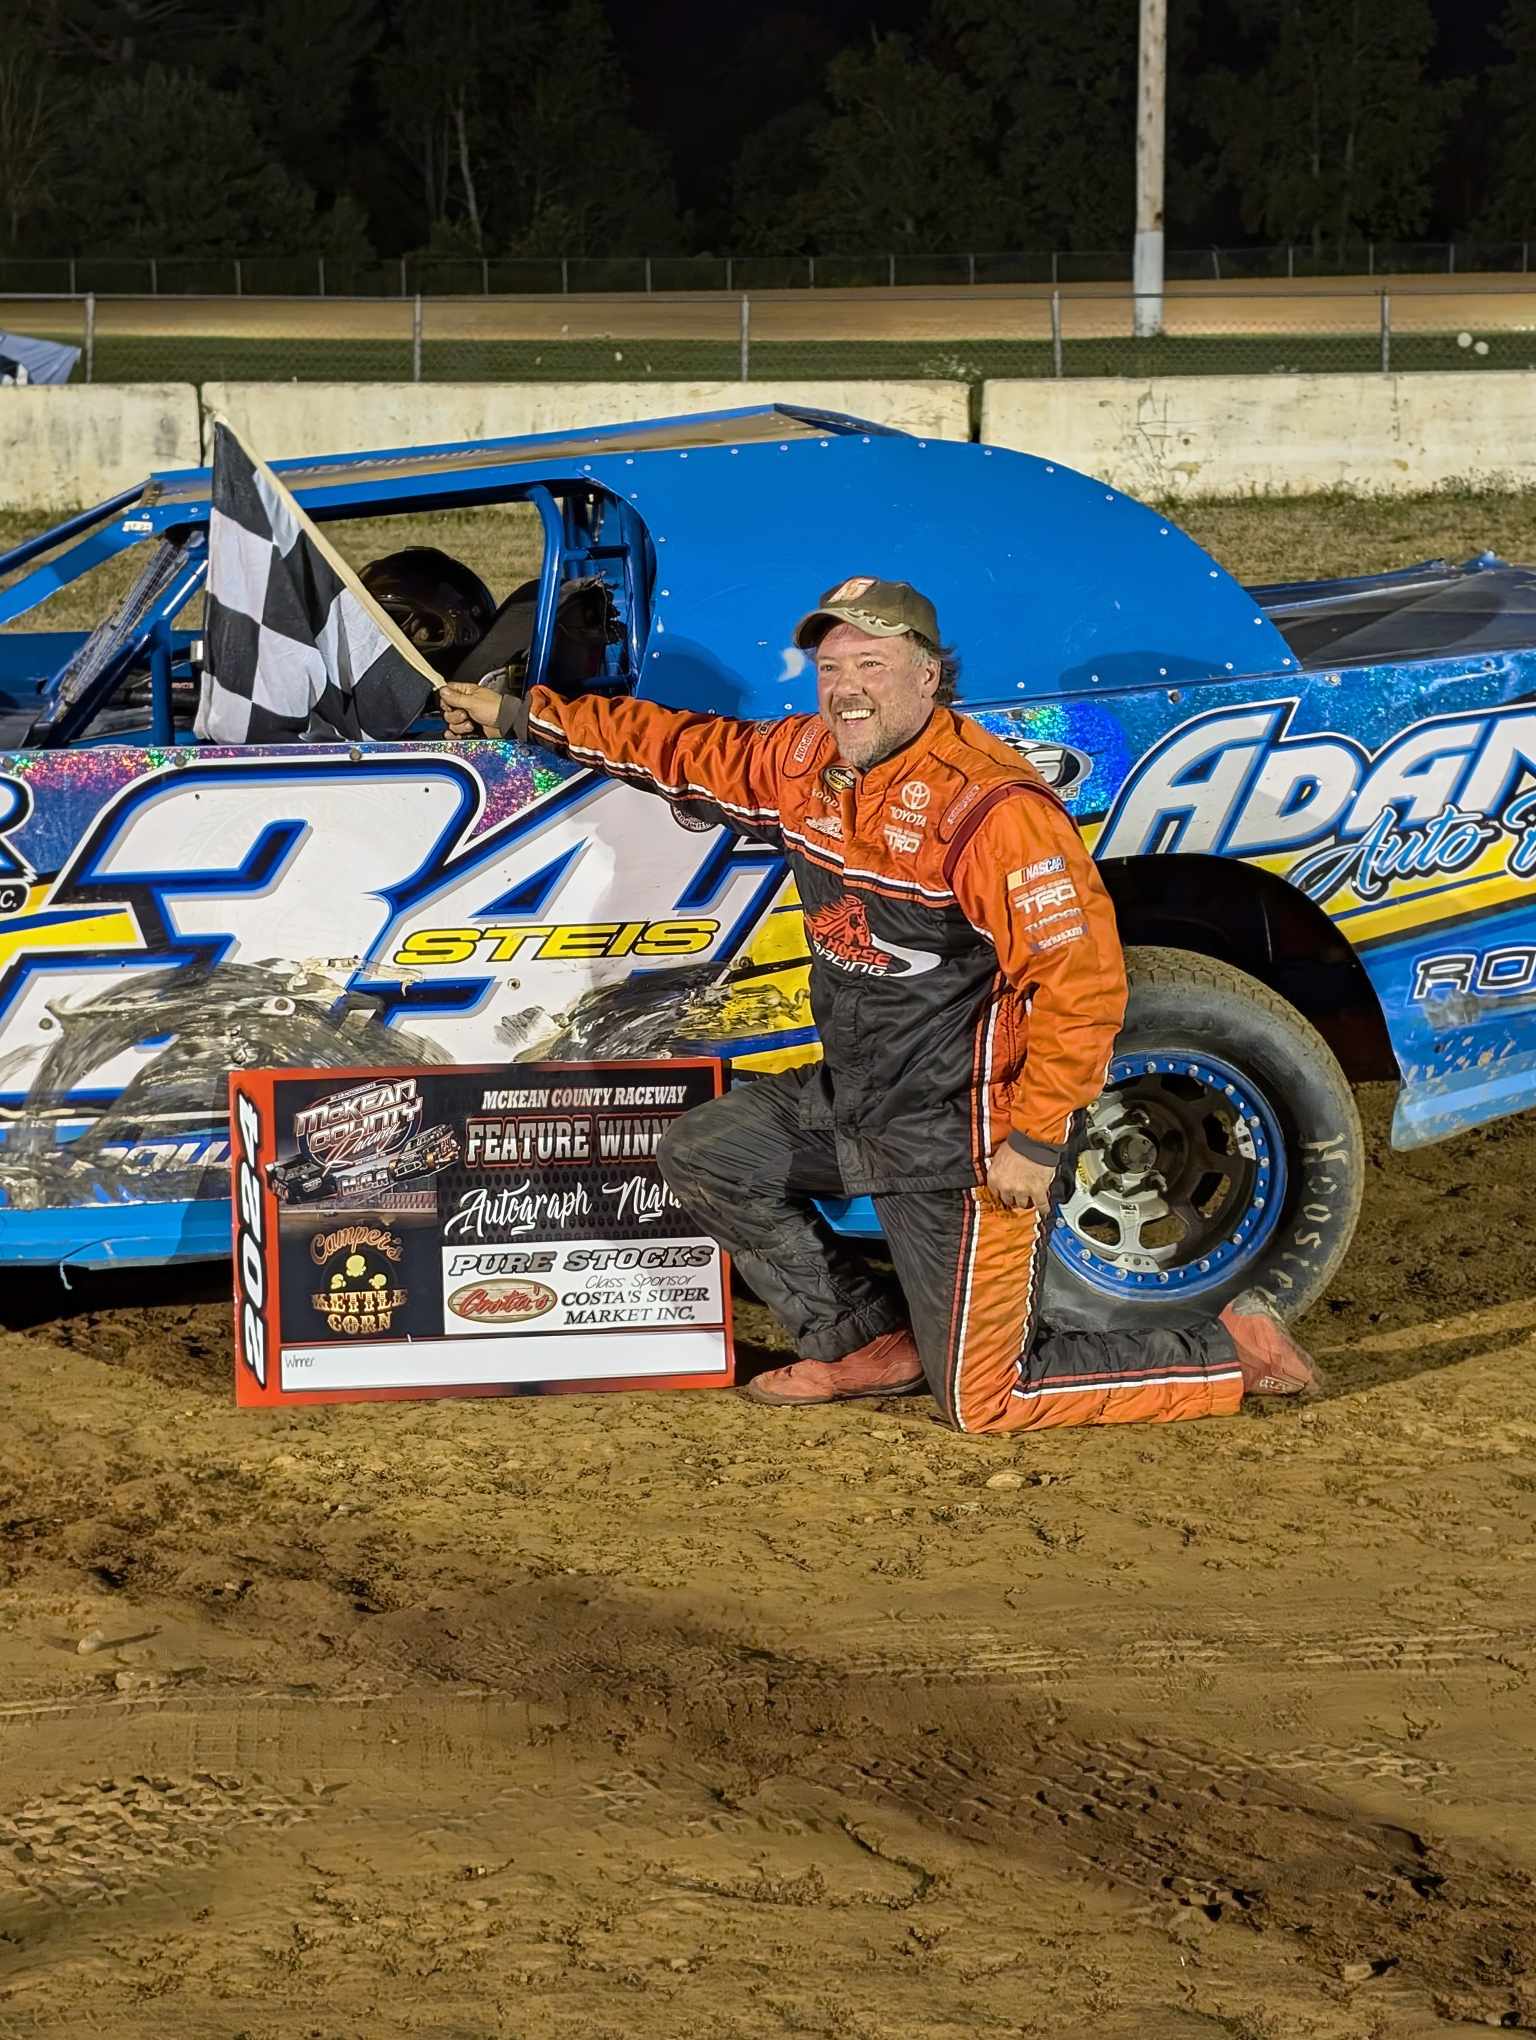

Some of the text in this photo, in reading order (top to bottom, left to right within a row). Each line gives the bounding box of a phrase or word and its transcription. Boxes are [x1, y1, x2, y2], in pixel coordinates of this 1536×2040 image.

[890, 806, 927, 828] TOYOTA
[884, 830, 922, 854] TRD
[1285, 803, 1496, 900] Auto
[1024, 857, 1065, 881] NASCAR
[1014, 883, 1077, 915] TRD
[393, 918, 720, 965] STEIS
[823, 936, 893, 967] HORSE
[482, 1085, 687, 1110] MCKEAN COUNTY RACEWAY
[309, 1096, 424, 1154] COUNTY
[467, 1120, 590, 1163] FEATURE
[444, 1175, 682, 1238] Autograph Nigh
[1253, 1132, 1350, 1304] HOOSI
[238, 1092, 267, 1388] 2024
[449, 1245, 715, 1276] PURE STOCKS
[561, 1287, 710, 1306] COSTA'S SUPER
[585, 1273, 696, 1294] Class Sponsor
[311, 1287, 409, 1314] KETTLE
[564, 1306, 696, 1325] MARKET INC.
[327, 1311, 393, 1335] CORN
